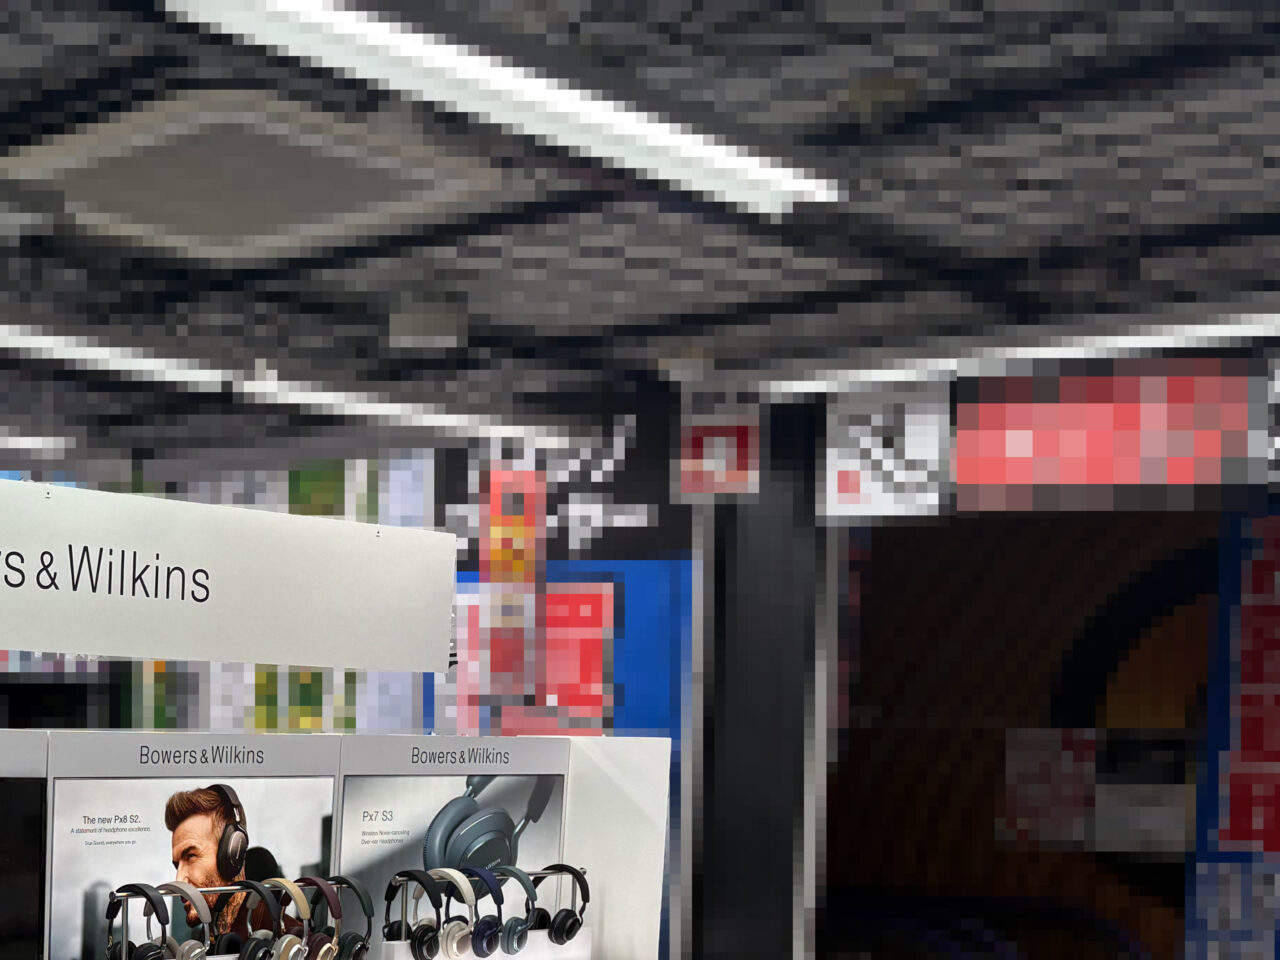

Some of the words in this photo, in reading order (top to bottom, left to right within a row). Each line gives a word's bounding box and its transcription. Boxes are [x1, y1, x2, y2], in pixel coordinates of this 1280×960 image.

[35, 550, 60, 591] &
[68, 543, 210, 603] Wilkins
[139, 745, 198, 765] Bowers
[199, 748, 209, 764] &
[211, 745, 264, 764] Wilkins
[411, 746, 457, 764] Bowers
[458, 750, 466, 764] &
[468, 747, 510, 765] Wilkins
[82, 815, 97, 825] The
[114, 815, 128, 824] Px8
[129, 814, 141, 824] S2.
[362, 810, 379, 822] Px7
[381, 810, 394, 822] S3
